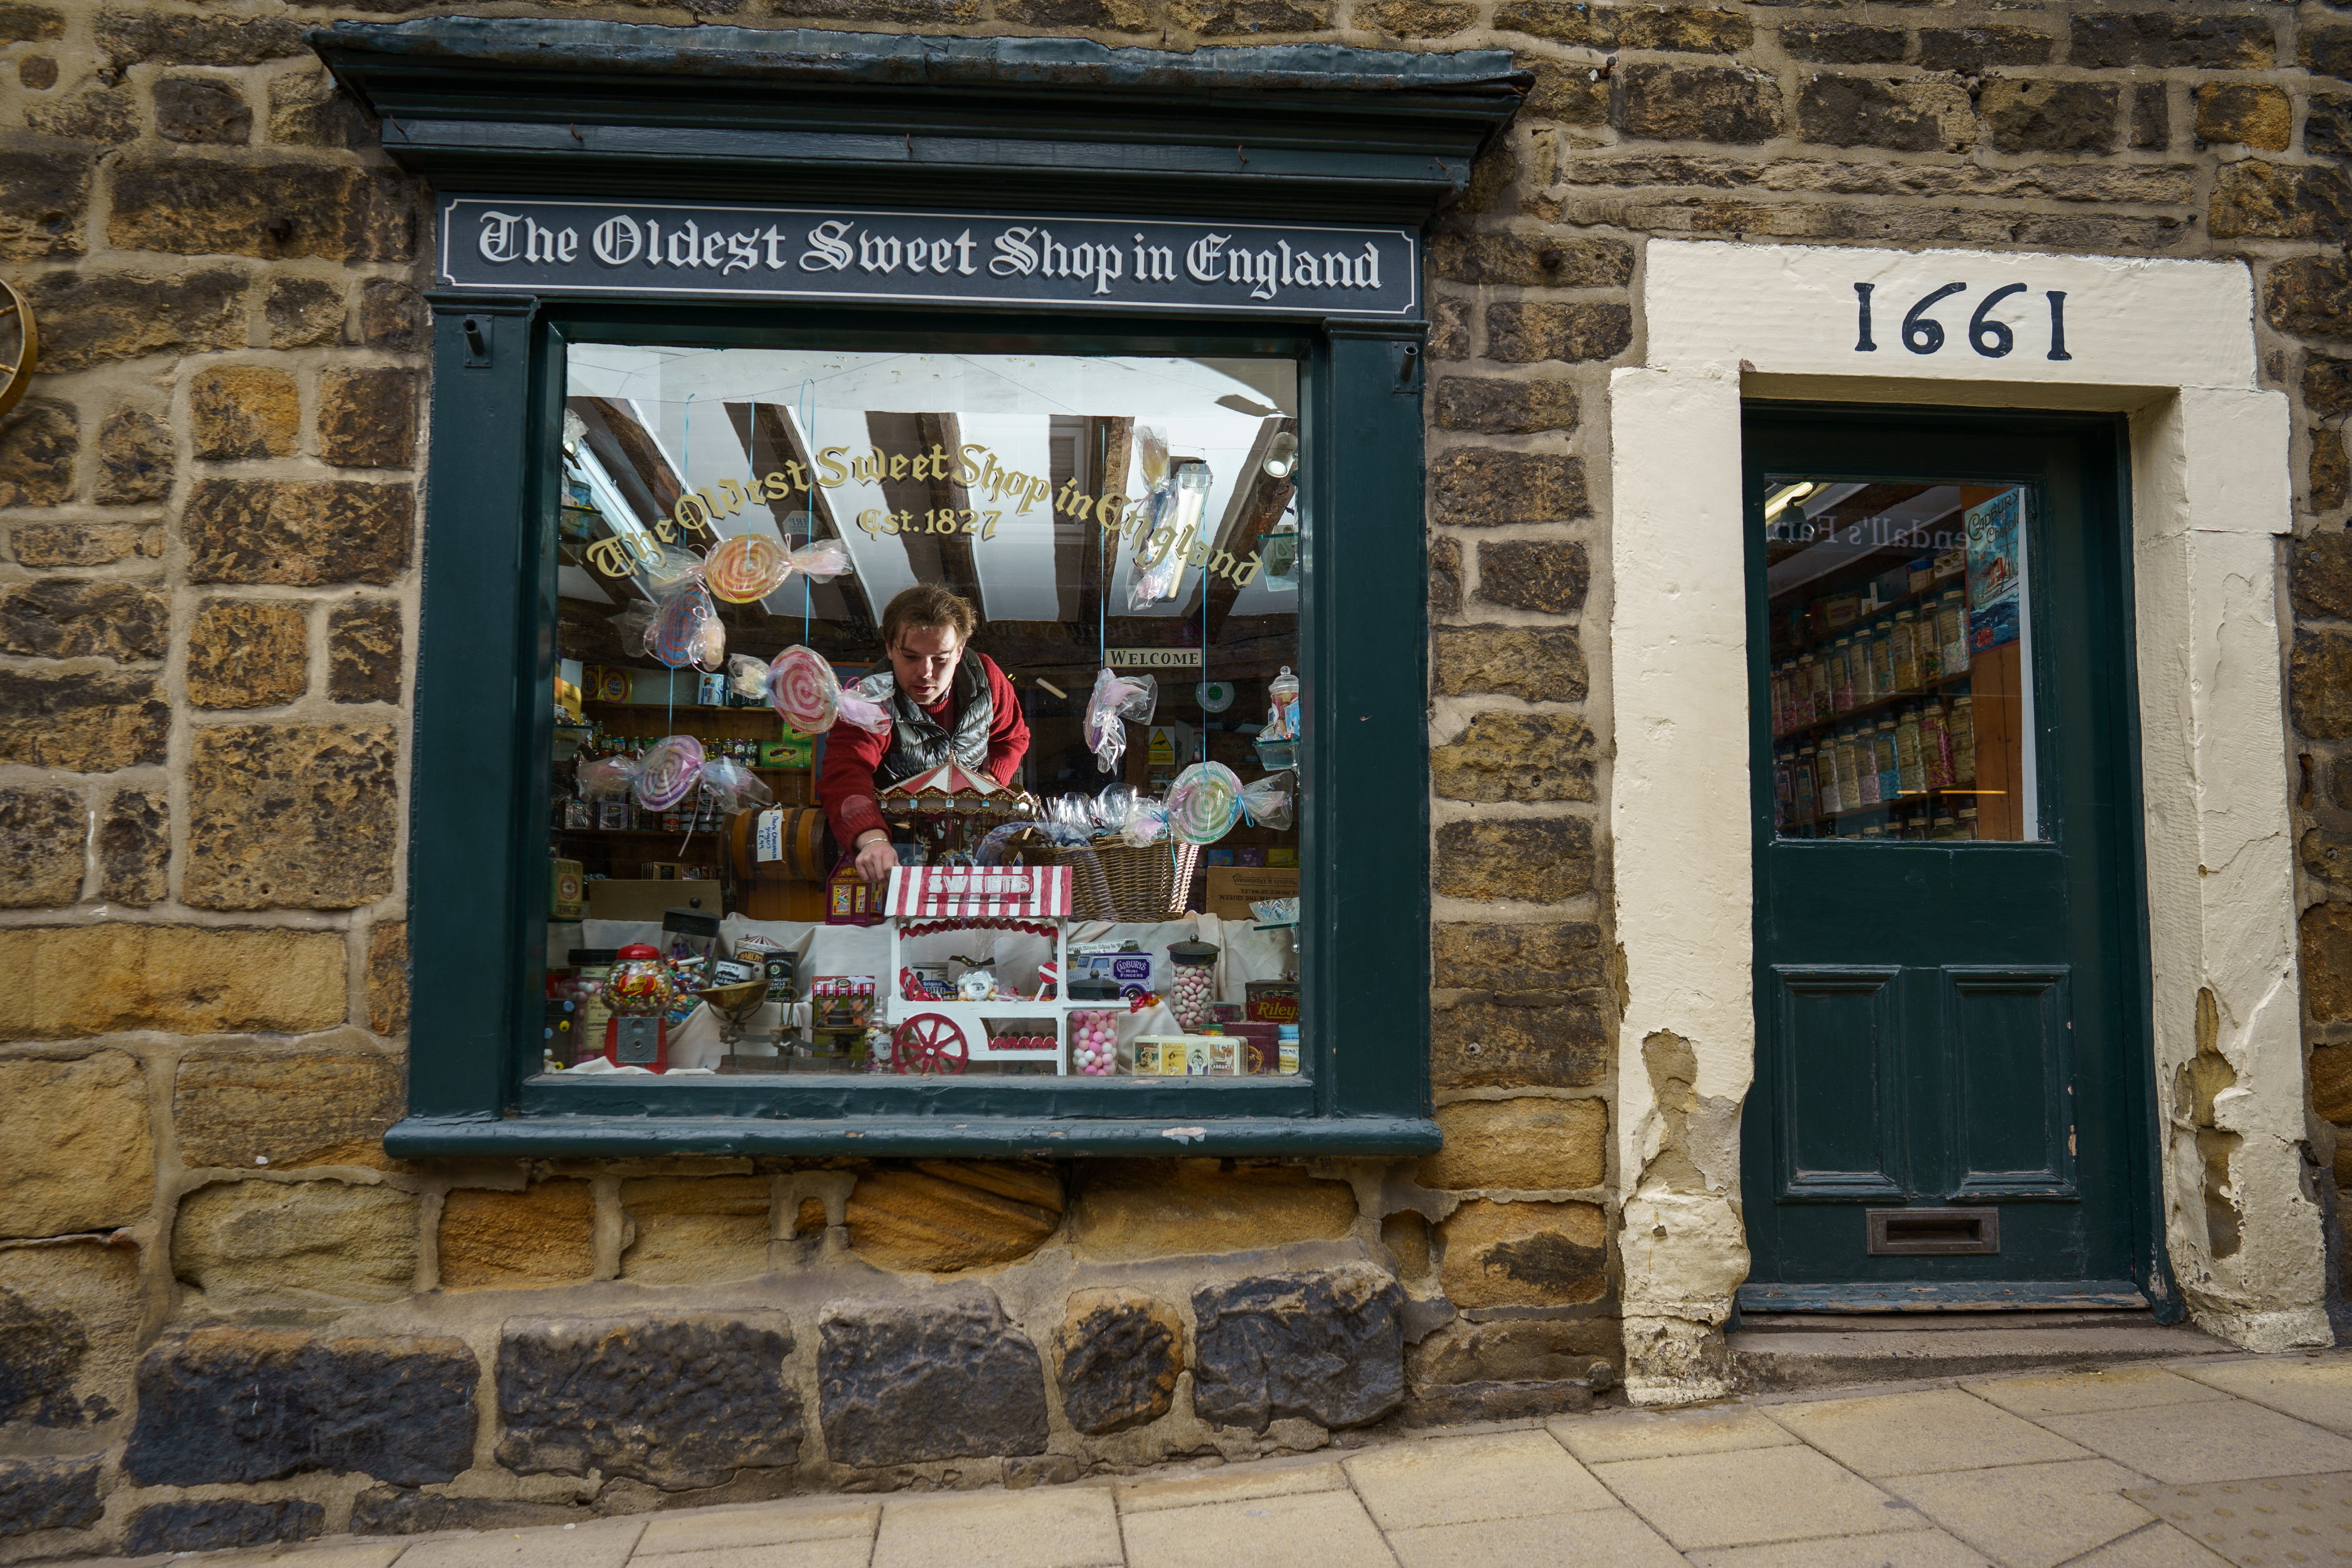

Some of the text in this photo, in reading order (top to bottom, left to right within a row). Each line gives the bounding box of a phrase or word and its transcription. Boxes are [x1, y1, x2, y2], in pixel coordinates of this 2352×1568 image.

[479, 210, 1383, 300] The Oldest Sweet Shop in England
[1854, 282, 2073, 361] 1661
[586, 443, 1264, 590] The Oldest Sweet Shop in England
[857, 507, 1003, 541] Est. 1827
[1110, 650, 1200, 666] WELCOME
[928, 875, 1033, 893] SWEETS
[1117, 960, 1147, 973] CADBURY'S
